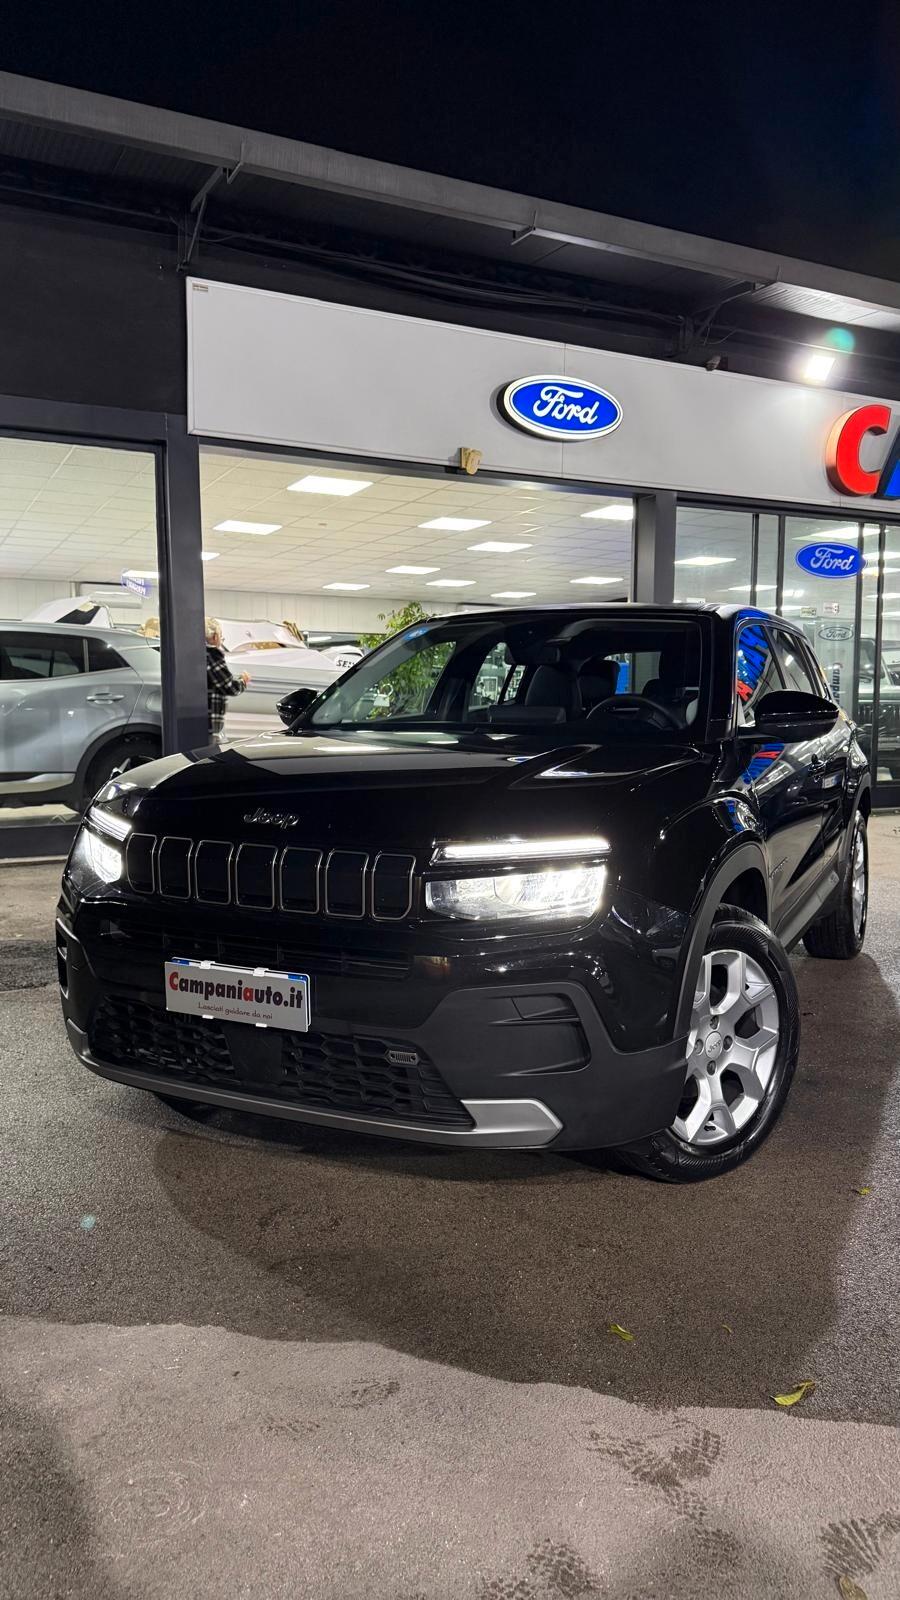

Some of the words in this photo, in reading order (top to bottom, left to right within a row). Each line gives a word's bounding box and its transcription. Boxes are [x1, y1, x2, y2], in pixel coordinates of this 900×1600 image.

[532, 385, 600, 425] Ford
[810, 547, 855, 570] Ford
[826, 628, 847, 639] Ford
[243, 807, 299, 829] Jeep
[169, 971, 303, 1009] Campaniauto.it
[198, 1001, 224, 1012] Lasciati
[224, 1007, 251, 1016] guidare
[251, 1009, 261, 1018] da
